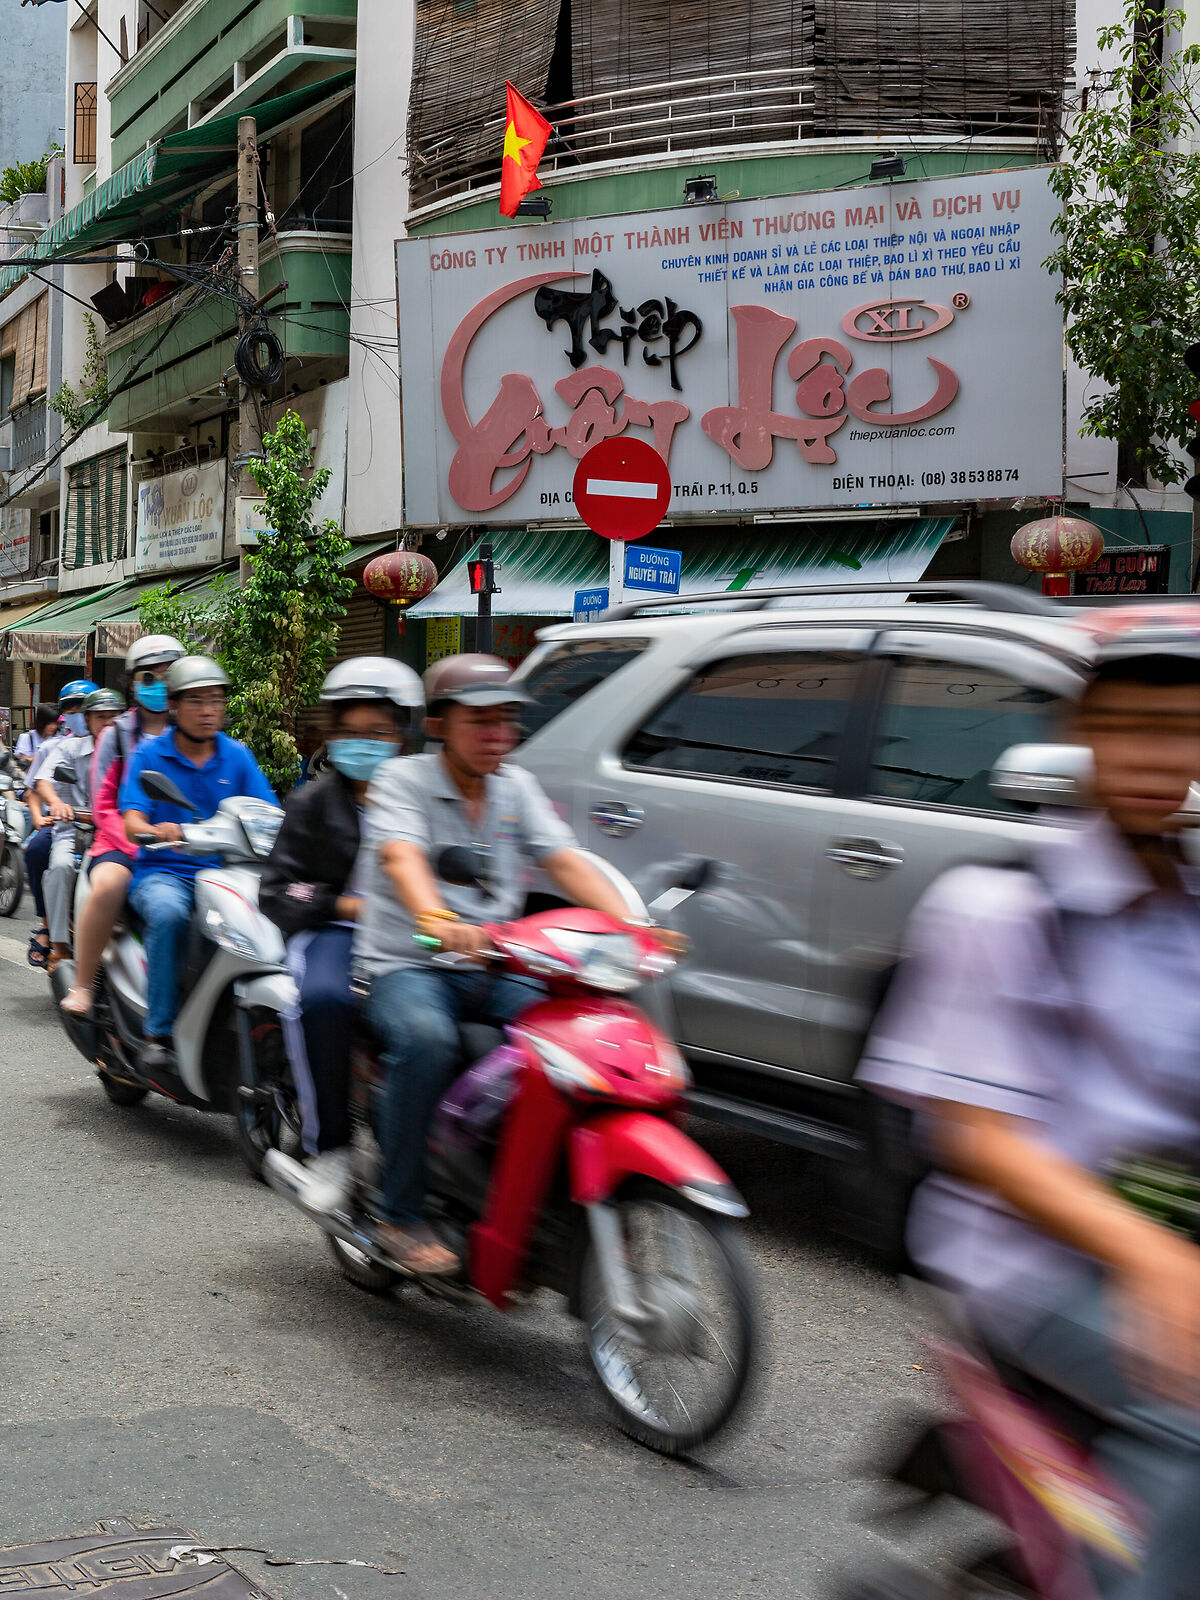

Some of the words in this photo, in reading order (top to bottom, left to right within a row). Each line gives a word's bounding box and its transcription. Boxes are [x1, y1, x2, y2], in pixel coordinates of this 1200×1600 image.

[430, 249, 476, 271] CÔNG
[484, 246, 508, 265] TY
[516, 240, 565, 261] TNHH
[574, 232, 615, 258] MỘT
[623, 225, 690, 250] THÀNH
[699, 217, 743, 242] VIÊN
[752, 210, 835, 236] THƯƠNG
[845, 205, 884, 229] MẠI
[895, 197, 921, 221] VÀ
[933, 194, 982, 219] DỊCH
[992, 189, 1021, 213] VỤ
[662, 254, 701, 270] CHUYÊN
[705, 253, 729, 265] KINH
[733, 249, 767, 262] DOANH
[786, 244, 799, 257] VÀ
[804, 241, 817, 255] LẺ
[821, 241, 841, 253] CÁC
[845, 239, 868, 252] LOẠI
[873, 234, 904, 248] THIỆP
[909, 230, 927, 245] NỘI
[933, 229, 946, 242] VÀ
[951, 227, 985, 241] NGOẠI
[989, 222, 1021, 237] NHẬP
[698, 267, 728, 283] THIẾT
[732, 265, 746, 280] KẾ
[750, 266, 763, 278] VÀ
[767, 263, 789, 276] LÀM
[793, 260, 814, 273] CÁC
[819, 259, 842, 272] LOẠI
[848, 254, 881, 268] THIỆP,
[883, 253, 904, 265] BAO
[908, 250, 918, 263] LÌ
[922, 248, 933, 261] XÌ
[937, 246, 966, 260] THEO
[971, 243, 993, 256] YÊU
[999, 238, 1021, 253] CẦU
[764, 280, 793, 293] NHẬN
[797, 277, 815, 290] GIA
[819, 274, 848, 288] CÔNG
[853, 271, 867, 285] BẾ
[871, 270, 884, 283] VÀ
[889, 267, 910, 281] DÁN
[915, 266, 937, 279] BAO
[941, 263, 966, 276] THƯ,
[968, 260, 990, 274] BAO
[995, 258, 1004, 271] LÌ
[1009, 256, 1021, 270] XÌ
[535, 267, 703, 391] Thiệp
[865, 307, 924, 334] XL
[700, 304, 960, 472] Lộc
[849, 425, 955, 442] thiepxuanloc.com
[540, 492, 560, 507] ĐỊA
[674, 482, 703, 497] TRÃI
[833, 474, 864, 492] ĐIỆN
[869, 473, 915, 490] THOẠI:
[921, 470, 945, 486] (08)
[192, 493, 214, 523] LỘC
[640, 552, 670, 566] ĐƯỜNG
[1115, 552, 1158, 575] CUỘN
[628, 566, 657, 582] NGUYỄN
